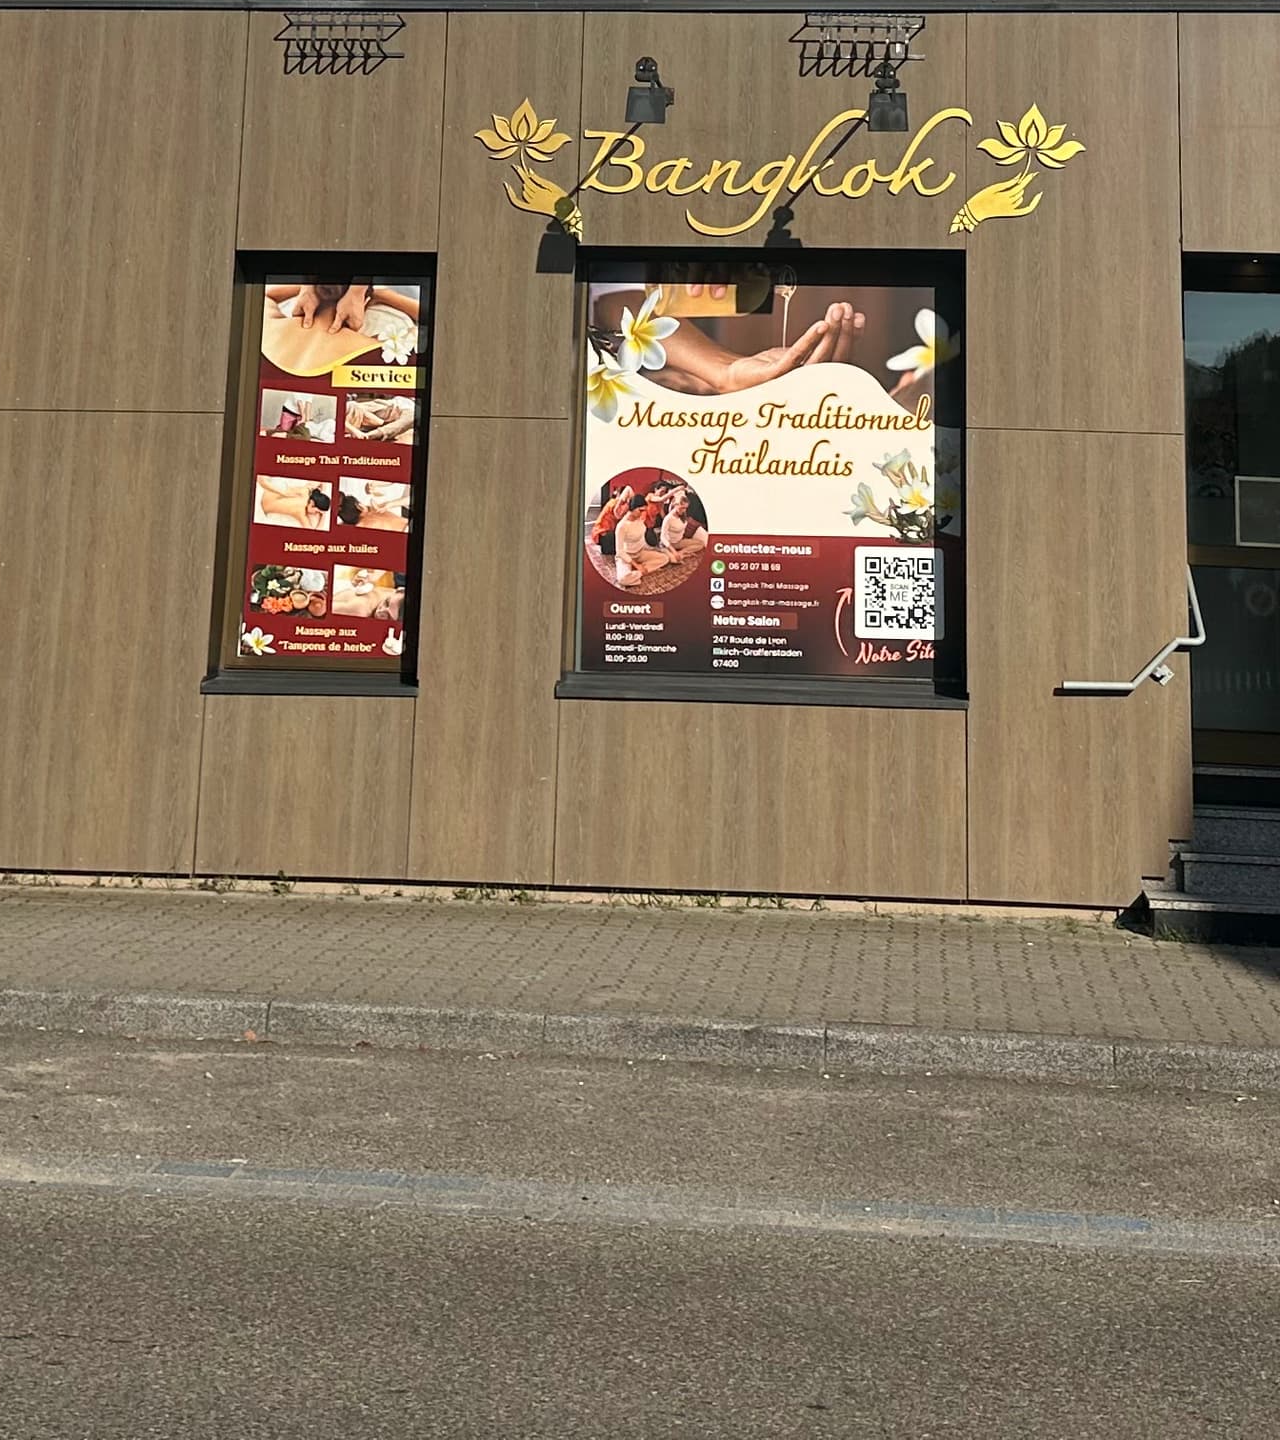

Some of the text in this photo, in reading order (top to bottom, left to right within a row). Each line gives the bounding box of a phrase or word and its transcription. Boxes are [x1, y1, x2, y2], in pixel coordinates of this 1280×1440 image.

[580, 107, 973, 236] Bangkok
[350, 369, 412, 383] Service
[618, 393, 933, 446] Massage Traditionnel
[276, 454, 316, 466] Massage
[342, 455, 401, 466] Traditionnel
[688, 437, 854, 476] Thaïlandais
[284, 543, 378, 554] Massage aux huiles
[714, 543, 812, 555] Contactez-nous
[728, 562, 739, 570] 06
[740, 562, 749, 570] 21
[749, 562, 760, 571] 07
[776, 582, 810, 591] Massage
[890, 591, 908, 602] ME
[610, 604, 651, 614] Ouvert
[713, 615, 780, 626] Notre Salon
[295, 626, 357, 637] Massage aux
[605, 623, 664, 631] Lundi-Vendredi
[328, 641, 342, 651] de
[712, 635, 787, 647] 247 Route de Lyon
[605, 644, 677, 653] Samedi-Dimanche
[855, 641, 902, 664] Notre
[713, 659, 739, 668] 67400
